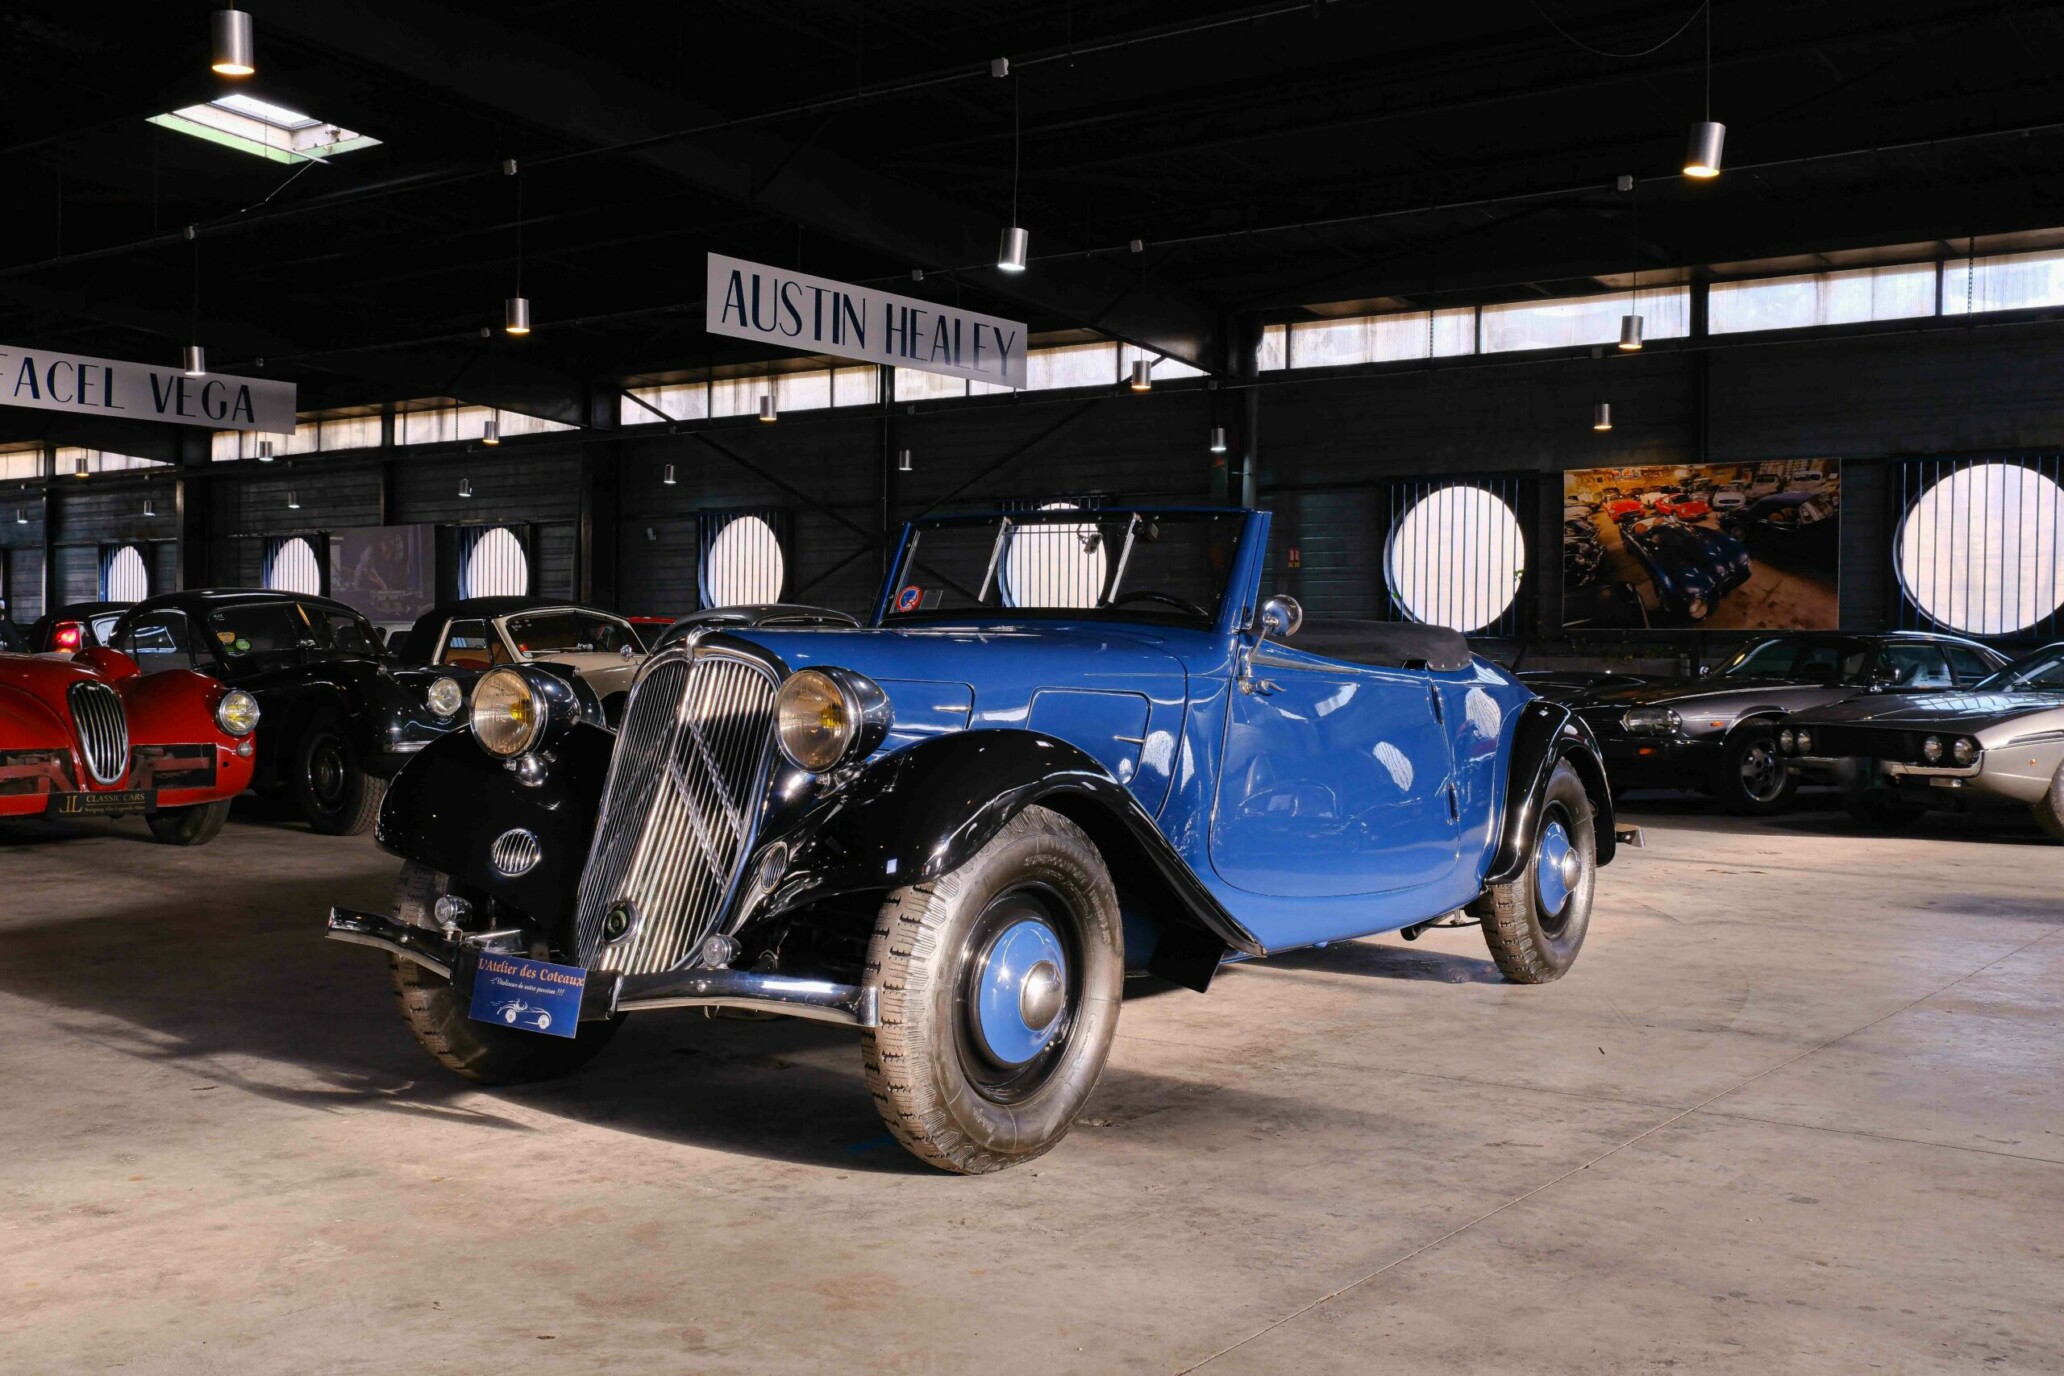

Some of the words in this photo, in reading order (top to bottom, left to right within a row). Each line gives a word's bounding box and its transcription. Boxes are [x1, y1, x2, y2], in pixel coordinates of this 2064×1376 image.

[722, 269, 866, 350] AUSTIN
[886, 302, 1016, 377] HEALEY
[150, 372, 255, 424] VEGA
[86, 794, 120, 803] CLASSIC
[122, 792, 145, 801] CARS
[478, 957, 518, 976] L'Atelier
[520, 964, 537, 979] des
[540, 968, 585, 987] Coteaux
